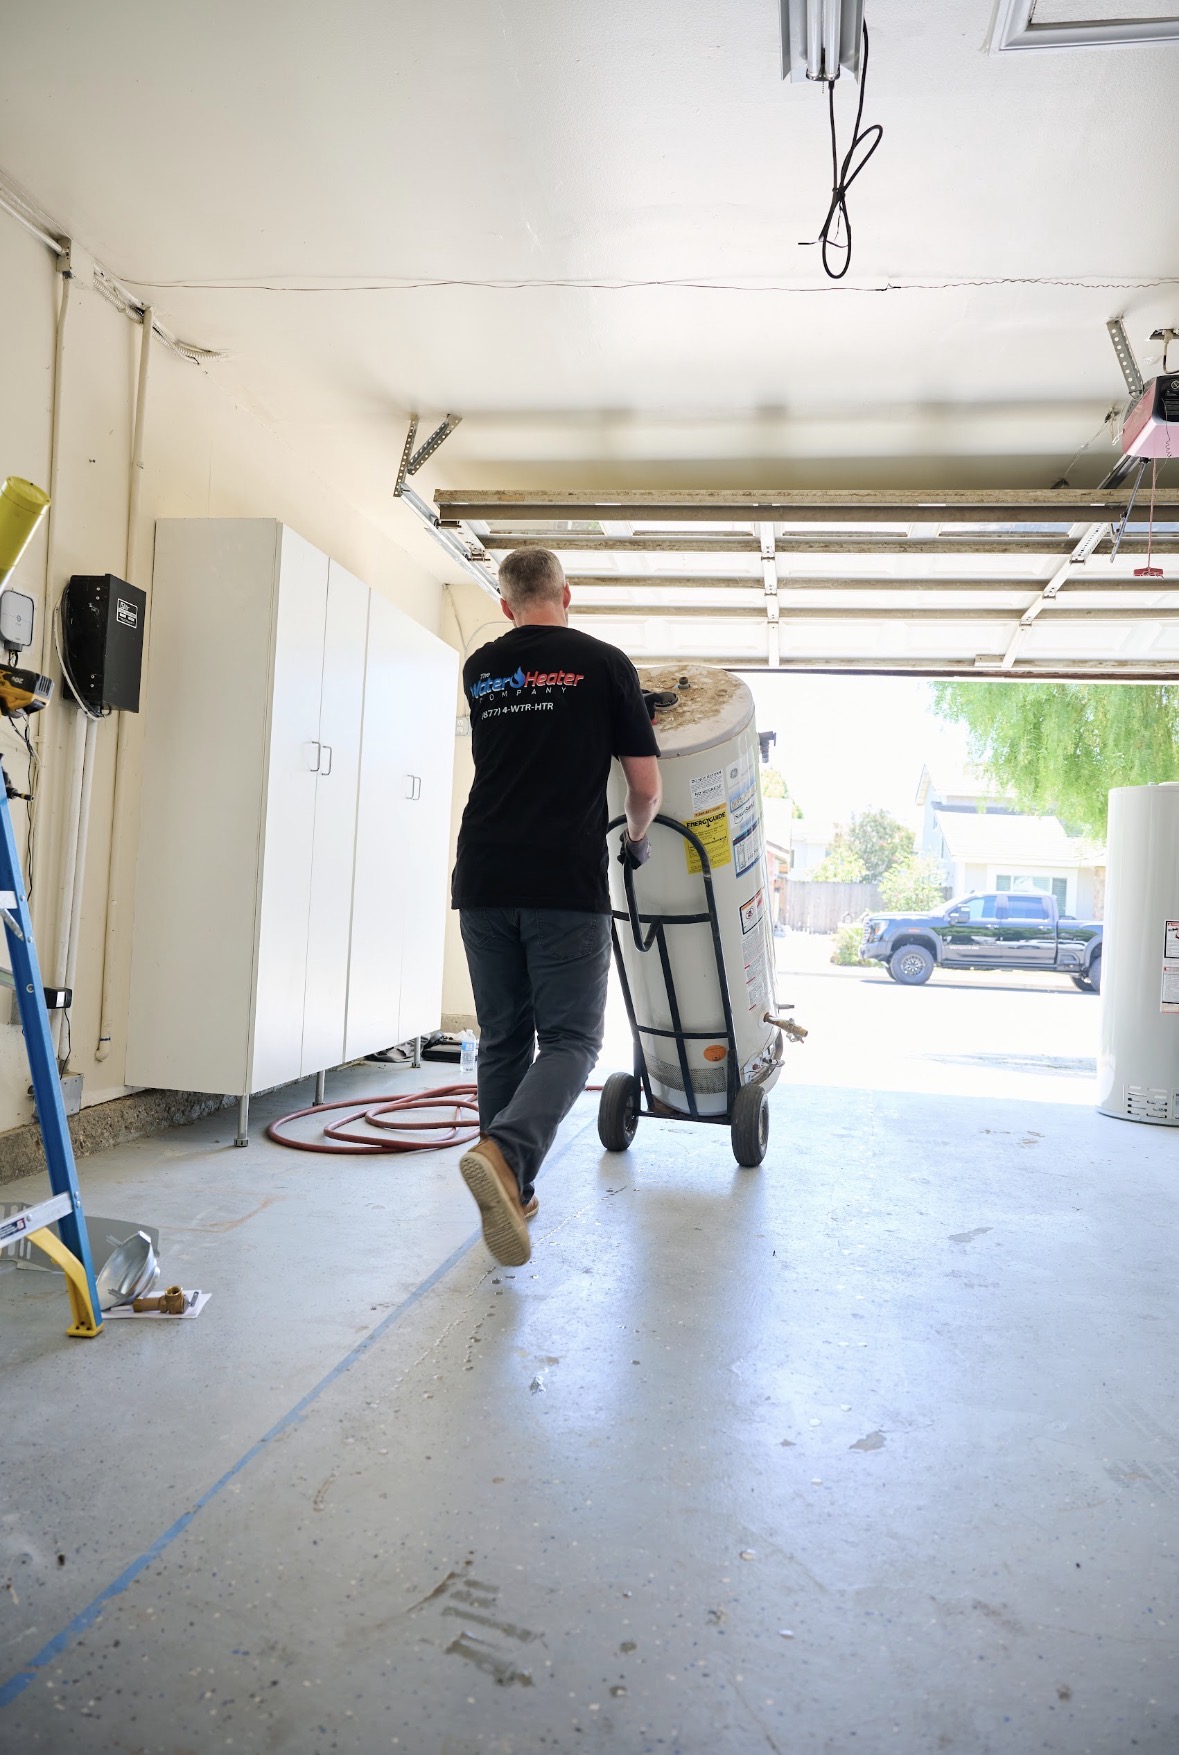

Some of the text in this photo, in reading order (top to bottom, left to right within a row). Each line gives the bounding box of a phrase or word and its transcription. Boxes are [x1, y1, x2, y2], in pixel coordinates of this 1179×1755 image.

[480, 672, 490, 680] The
[470, 670, 585, 699] Water Heater
[502, 702, 554, 714] 4-WTR-HTR
